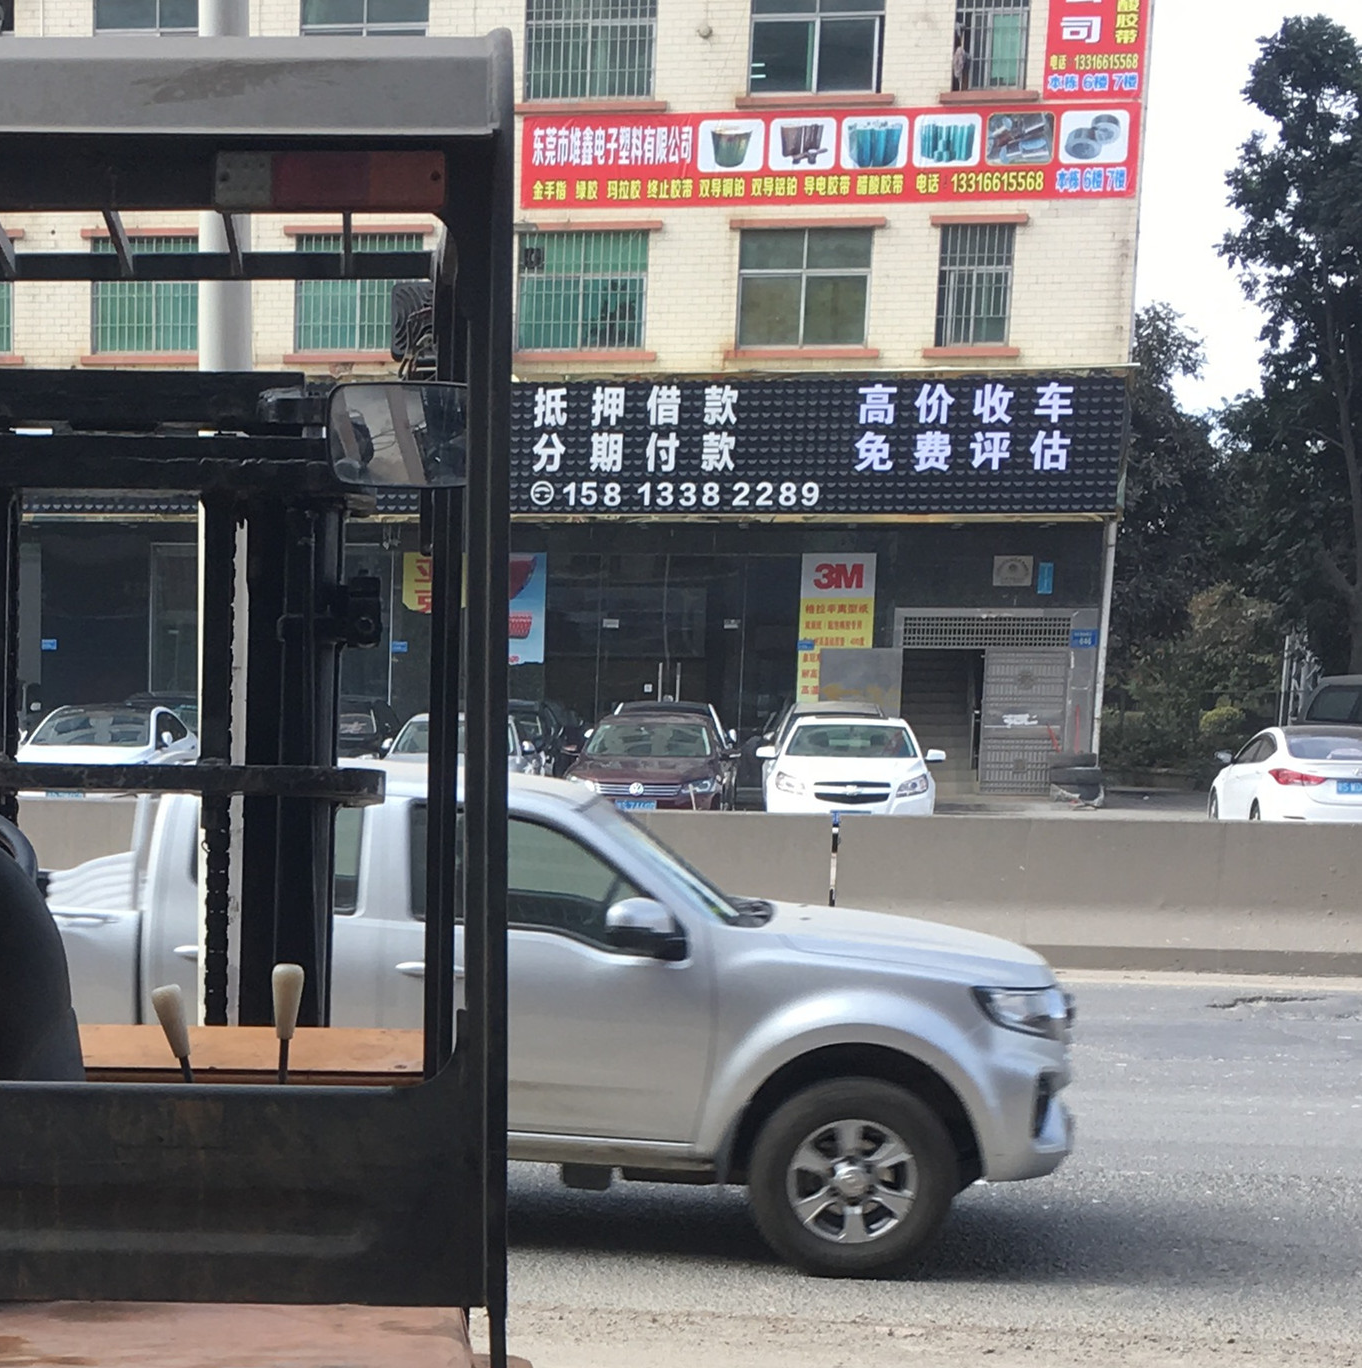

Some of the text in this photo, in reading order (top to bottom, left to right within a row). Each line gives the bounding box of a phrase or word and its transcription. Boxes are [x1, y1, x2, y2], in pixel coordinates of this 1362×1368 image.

[534, 382, 1075, 428] 抵押借款 高价收车
[532, 430, 1072, 473] 分期付款 免费评估
[562, 481, 820, 507] 158 1338 2289
[813, 563, 864, 590] 3M
